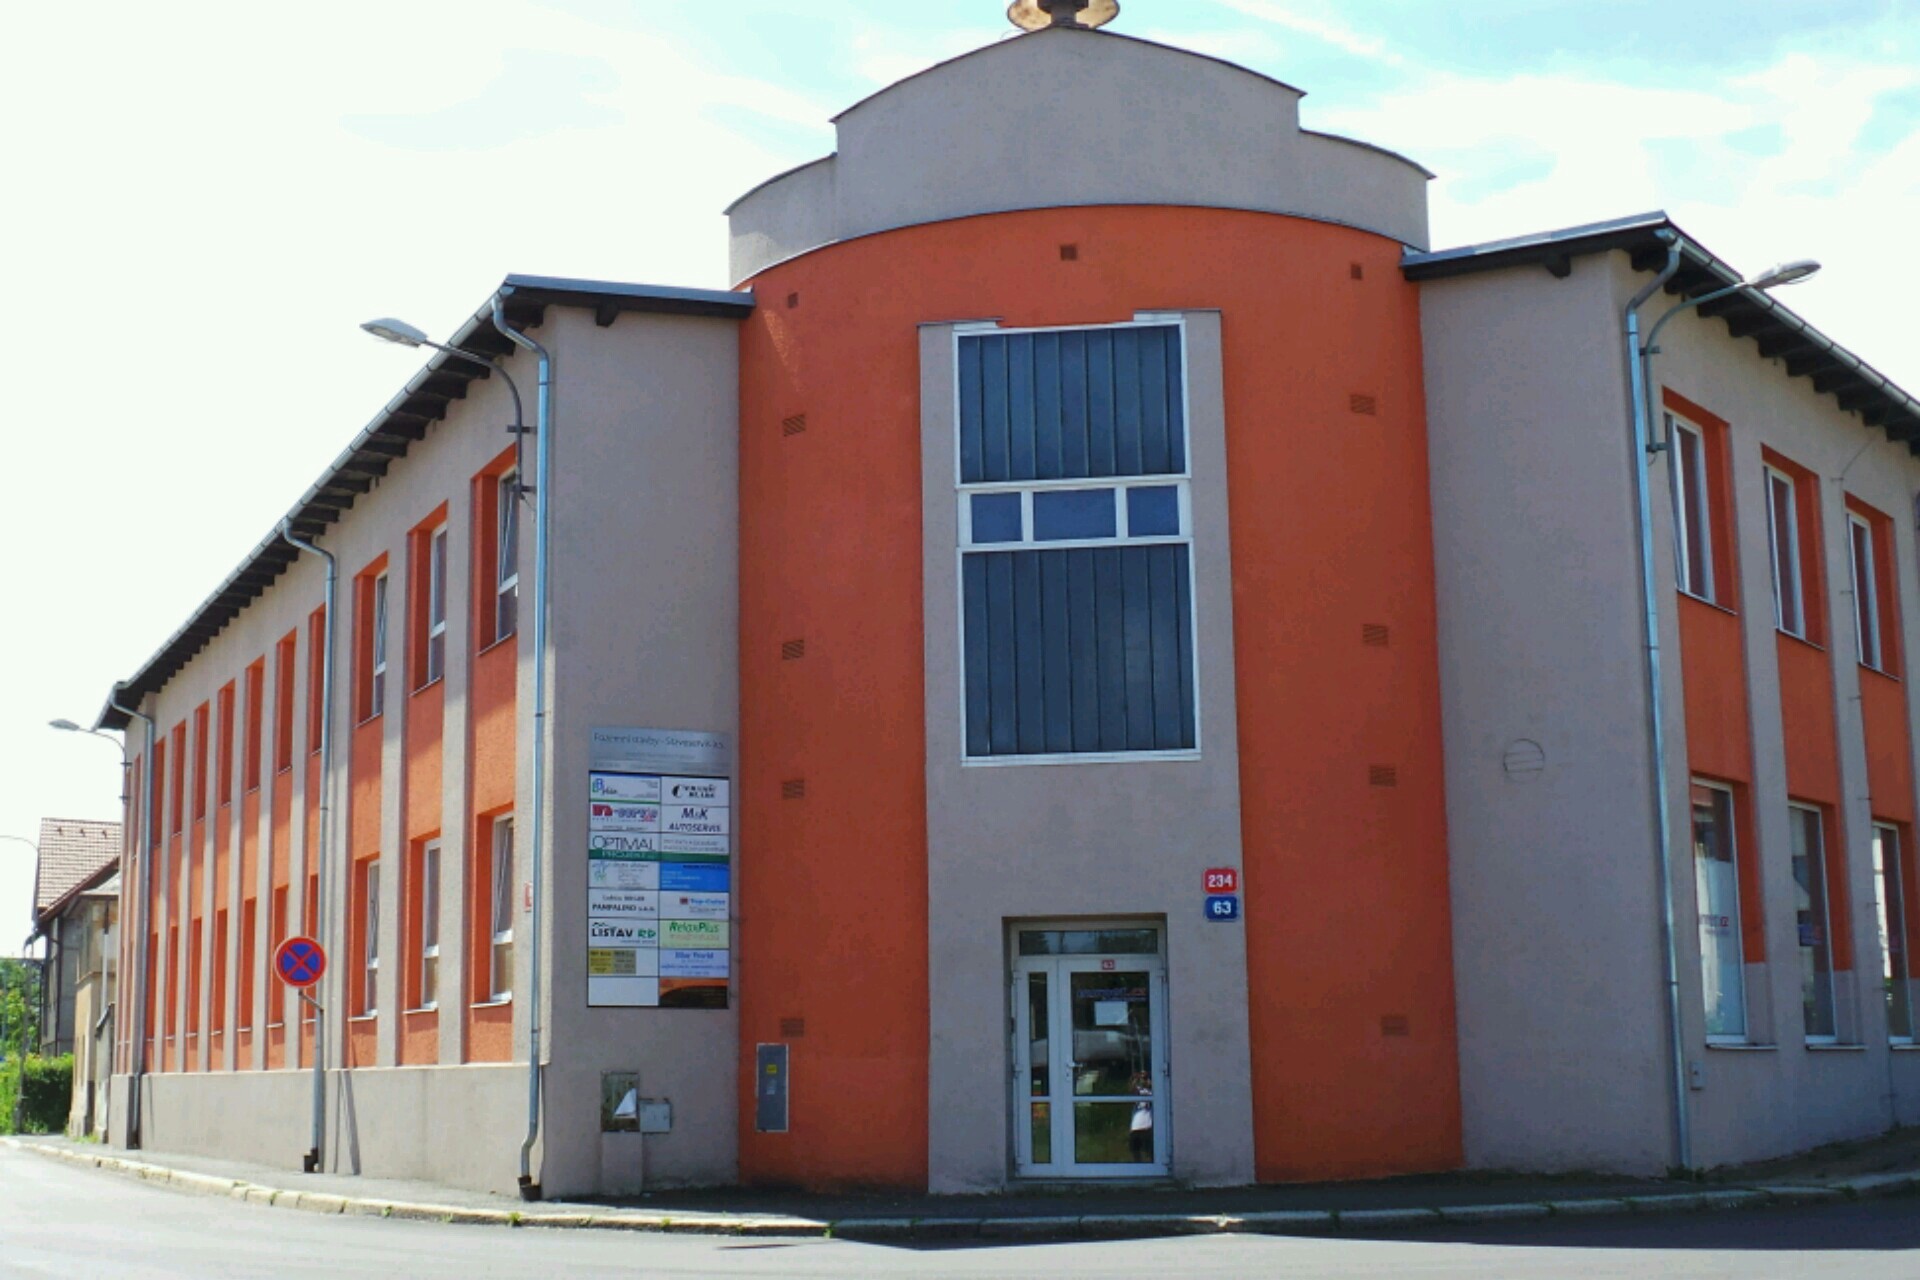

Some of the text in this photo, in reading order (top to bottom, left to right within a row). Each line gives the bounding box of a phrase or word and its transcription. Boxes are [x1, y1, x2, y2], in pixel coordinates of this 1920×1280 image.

[592, 835, 655, 851] OPTIMAL
[1208, 874, 1233, 888] 234
[1213, 901, 1231, 915] 63
[592, 928, 633, 938] LISTAV
